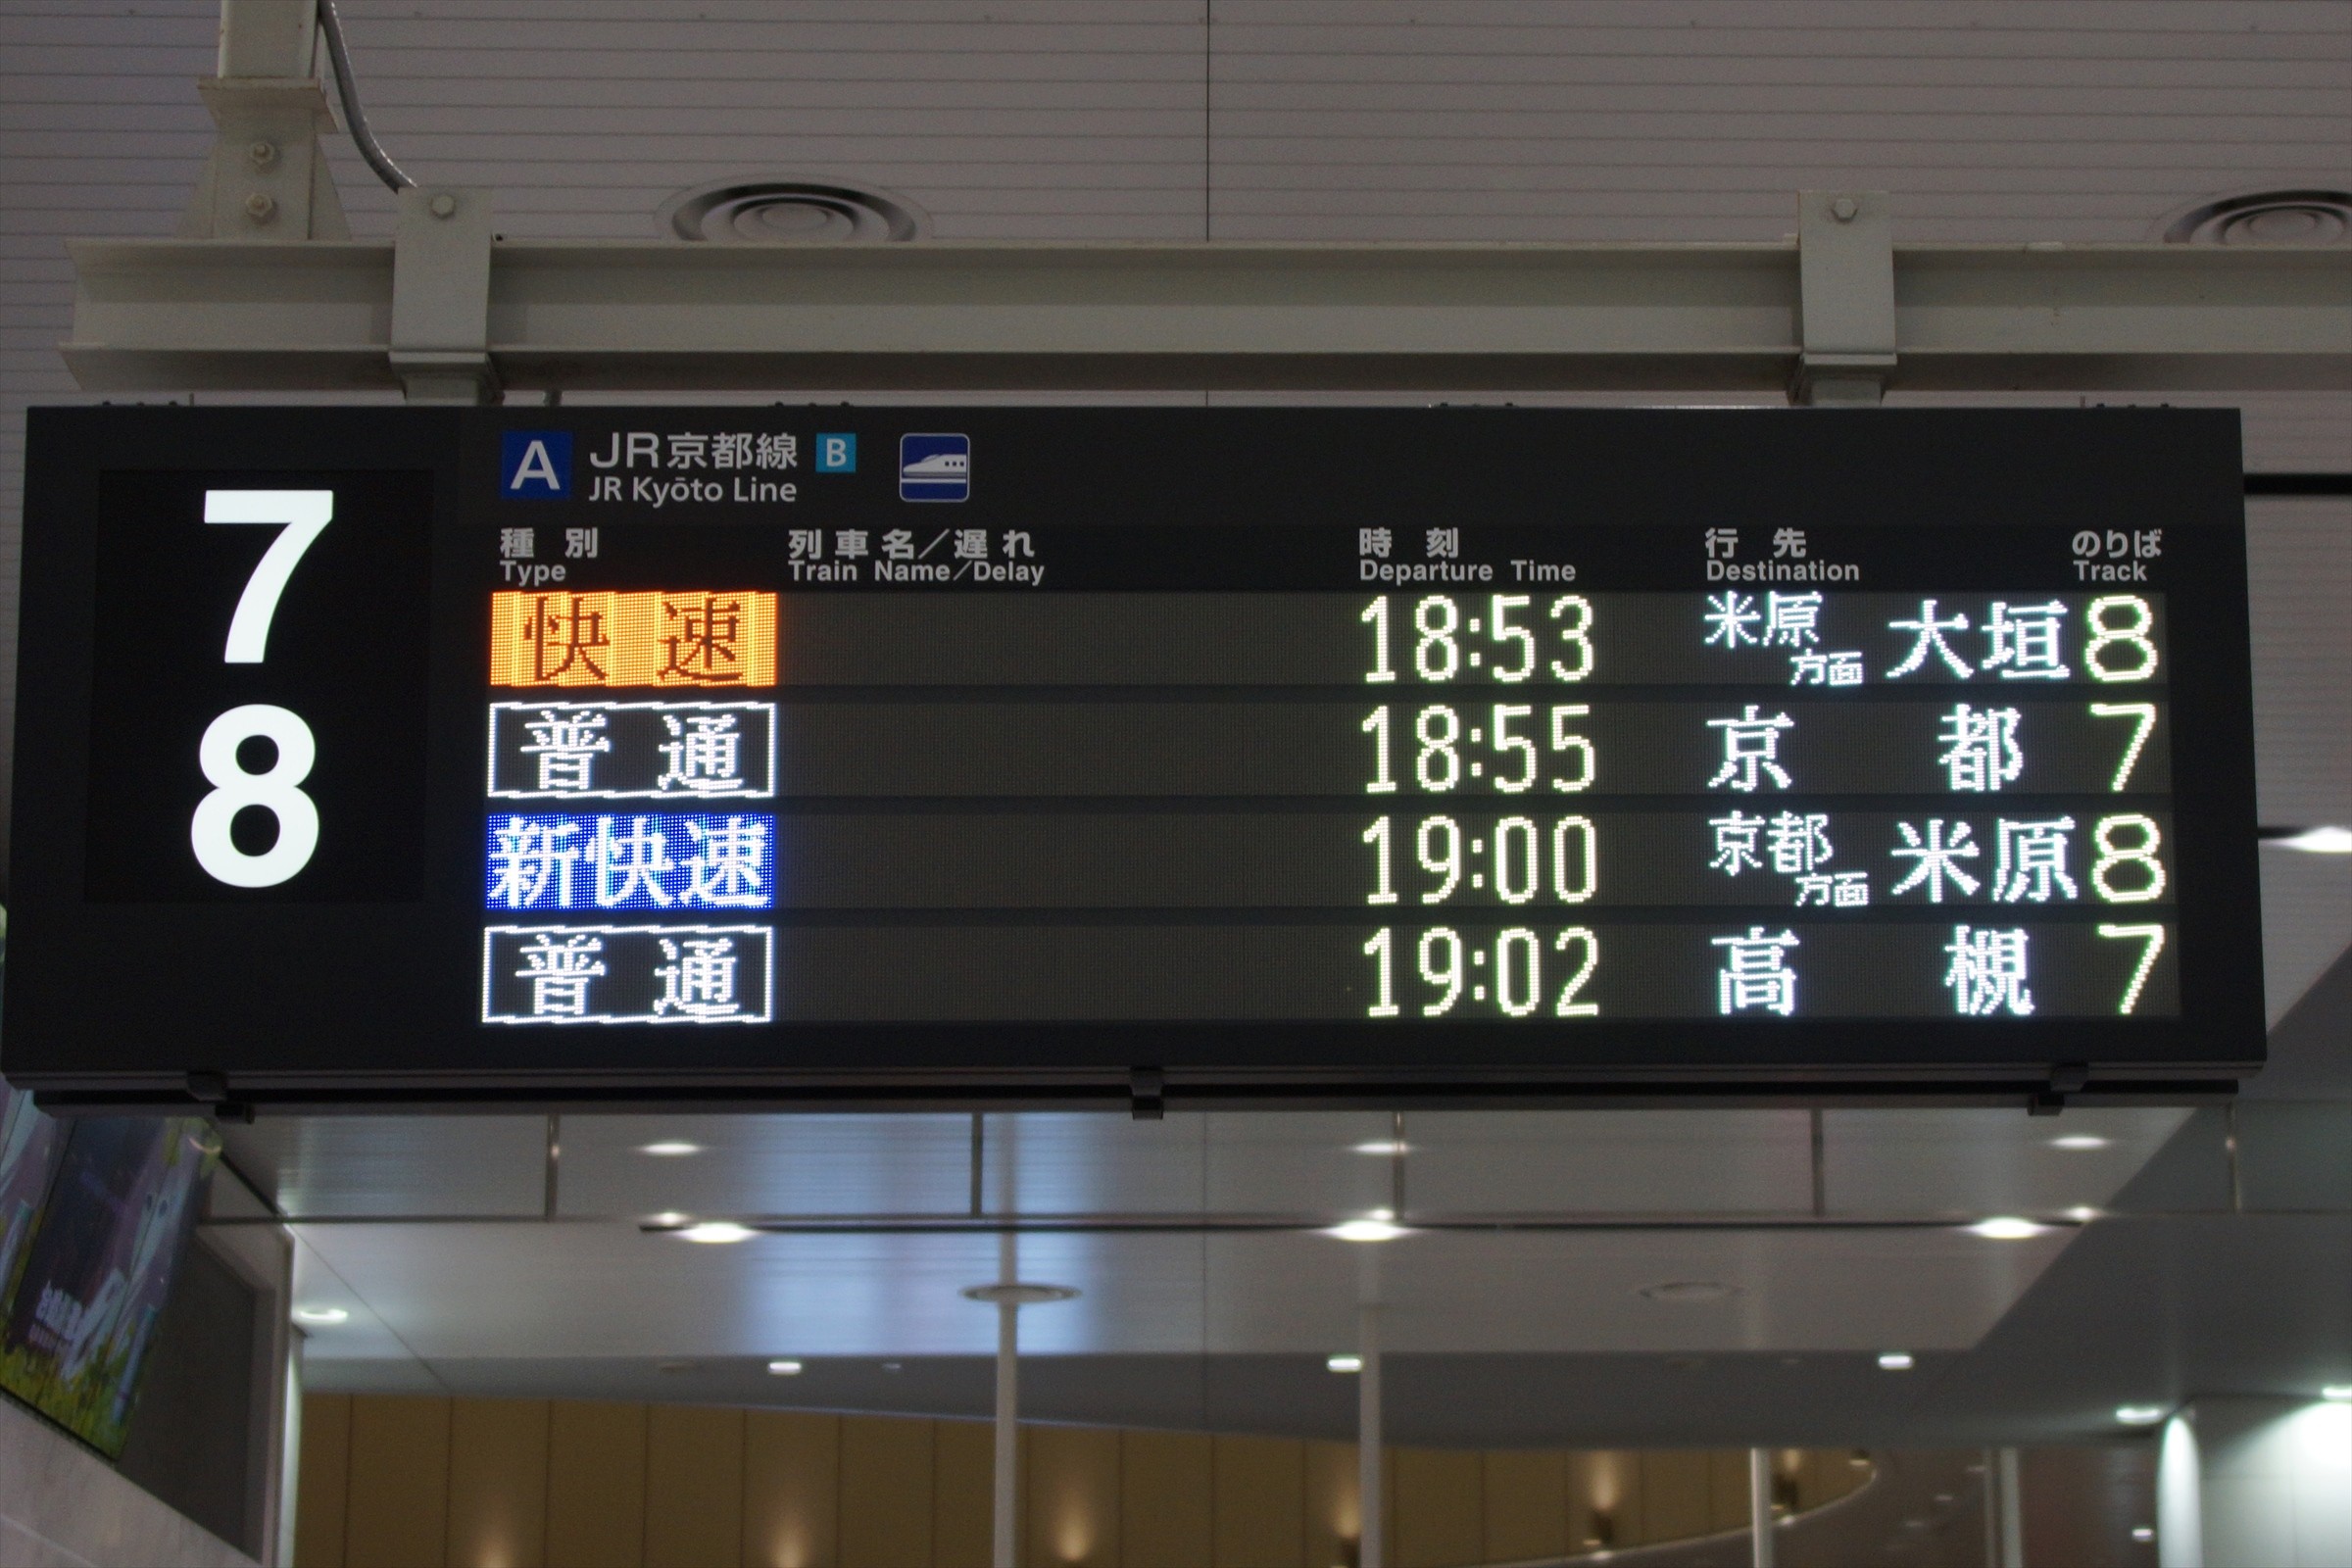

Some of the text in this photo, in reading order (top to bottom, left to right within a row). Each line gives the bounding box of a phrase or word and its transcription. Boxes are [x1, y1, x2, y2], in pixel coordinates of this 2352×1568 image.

[510, 440, 561, 490] A
[588, 475, 622, 502] JR
[733, 476, 797, 503] Line
[589, 431, 798, 470] JR京都線
[825, 437, 848, 467] B
[204, 490, 333, 663] 7
[499, 561, 566, 586] Type
[787, 558, 858, 582] Train
[1359, 559, 1577, 587] Departure Time
[1706, 559, 1860, 581] Destination
[2072, 528, 2163, 559] のりば
[2073, 560, 2148, 582] Track
[1361, 594, 1593, 683] 18:53
[2084, 595, 2158, 682] 8
[1362, 704, 1594, 793] 18:55
[2090, 703, 2156, 792] 7
[191, 704, 318, 888] 8
[489, 815, 769, 907] 新快速
[1363, 815, 1596, 905] 19:00
[2092, 814, 2166, 903] 8
[1364, 927, 1598, 1017] 19:02
[2098, 924, 2165, 1014] 7
